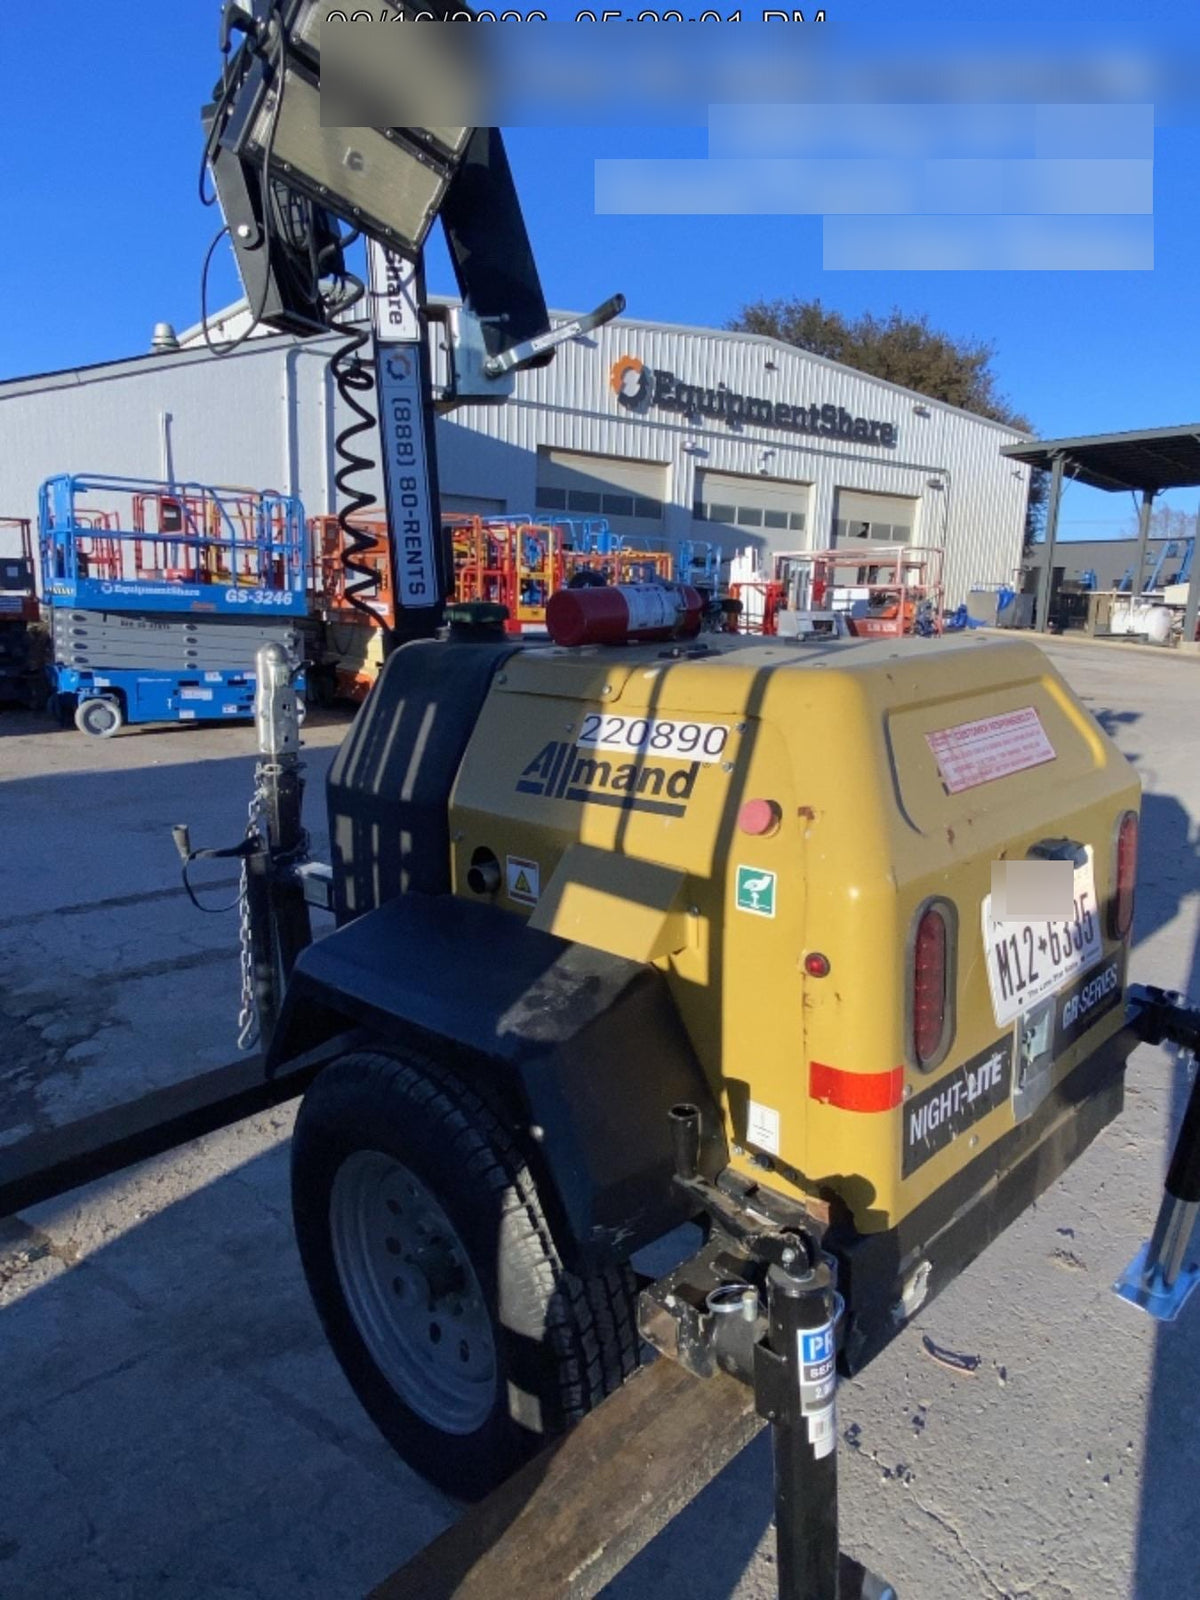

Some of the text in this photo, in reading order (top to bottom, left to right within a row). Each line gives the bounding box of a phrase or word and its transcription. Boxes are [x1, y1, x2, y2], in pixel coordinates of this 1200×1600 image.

[652, 369, 896, 447] EquipmentShare
[391, 397, 426, 596] (888) 80-RENTS
[225, 588, 293, 606] GS-3246
[517, 741, 701, 799] Allmand
[578, 715, 728, 755] 220890
[995, 925, 1040, 1002] M12
[909, 1051, 1003, 1146] NIGHT-LITE
